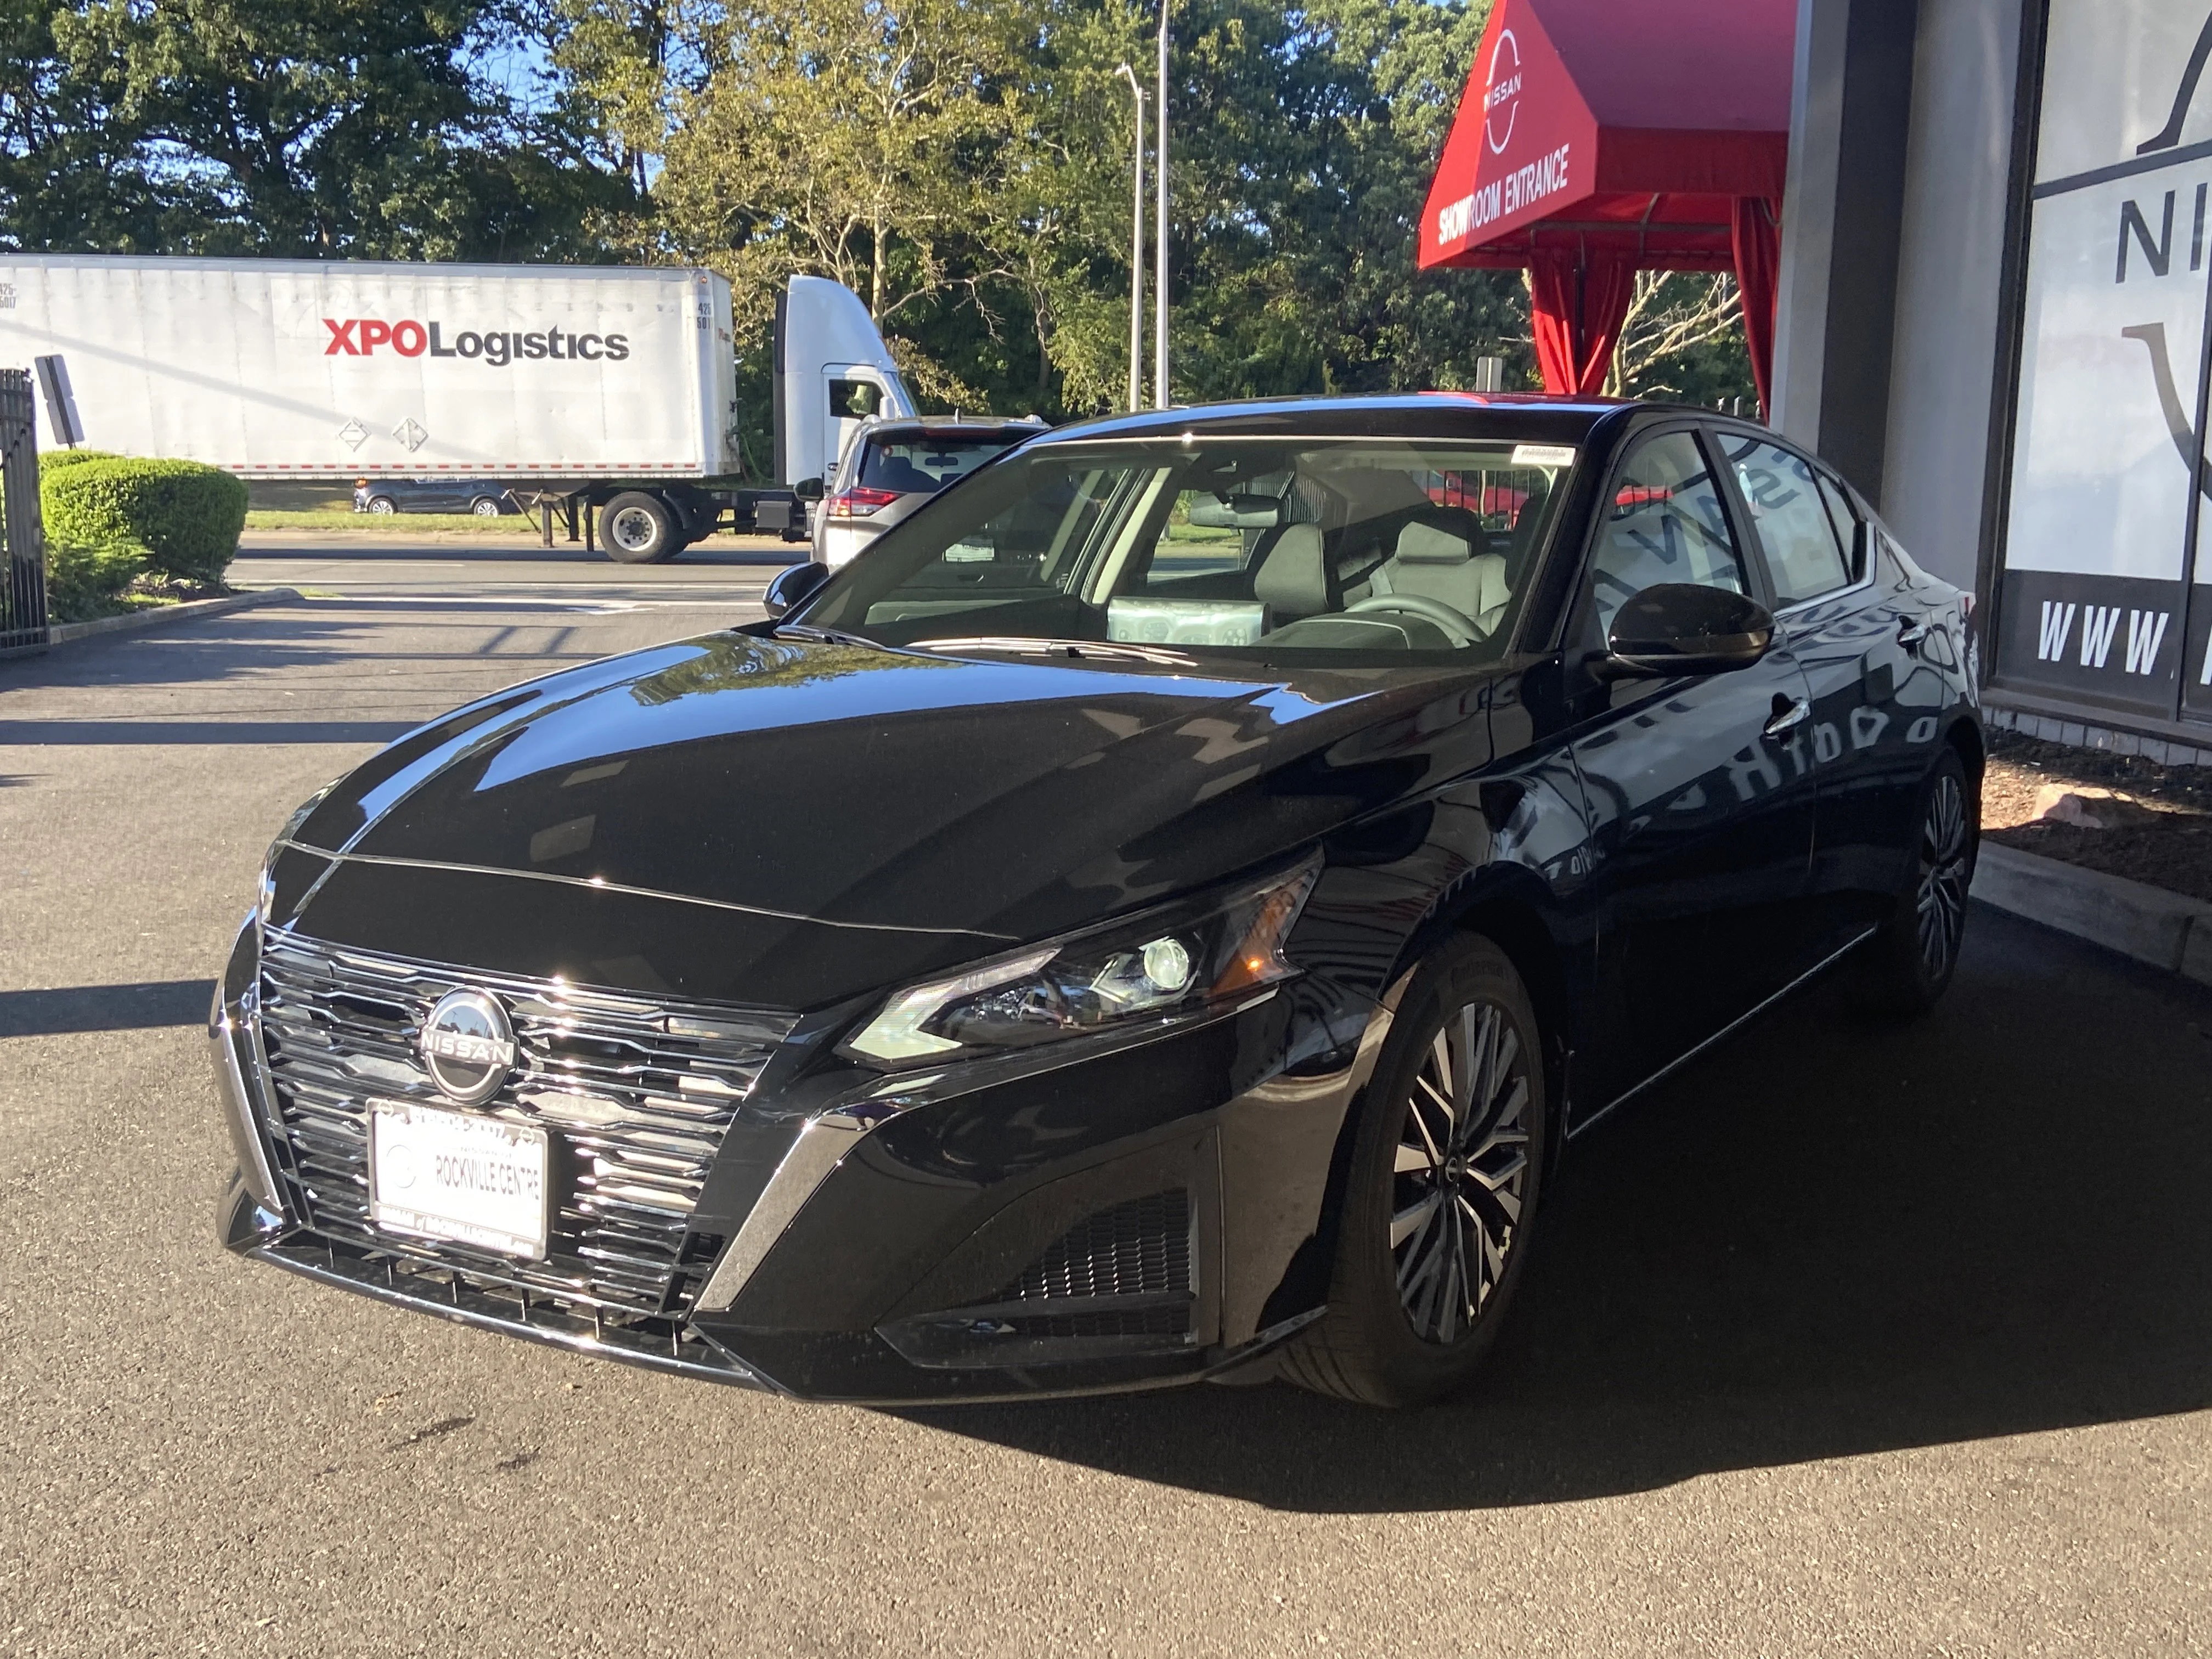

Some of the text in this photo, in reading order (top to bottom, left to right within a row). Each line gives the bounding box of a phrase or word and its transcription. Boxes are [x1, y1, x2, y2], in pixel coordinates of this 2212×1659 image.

[1484, 72, 1521, 112] NISSAN
[1438, 143, 1570, 246] SHOWROOM ENTRANCE
[421, 1031, 511, 1063] NISSAN
[437, 1155, 539, 1200] ROCKVILLE CENTRE
